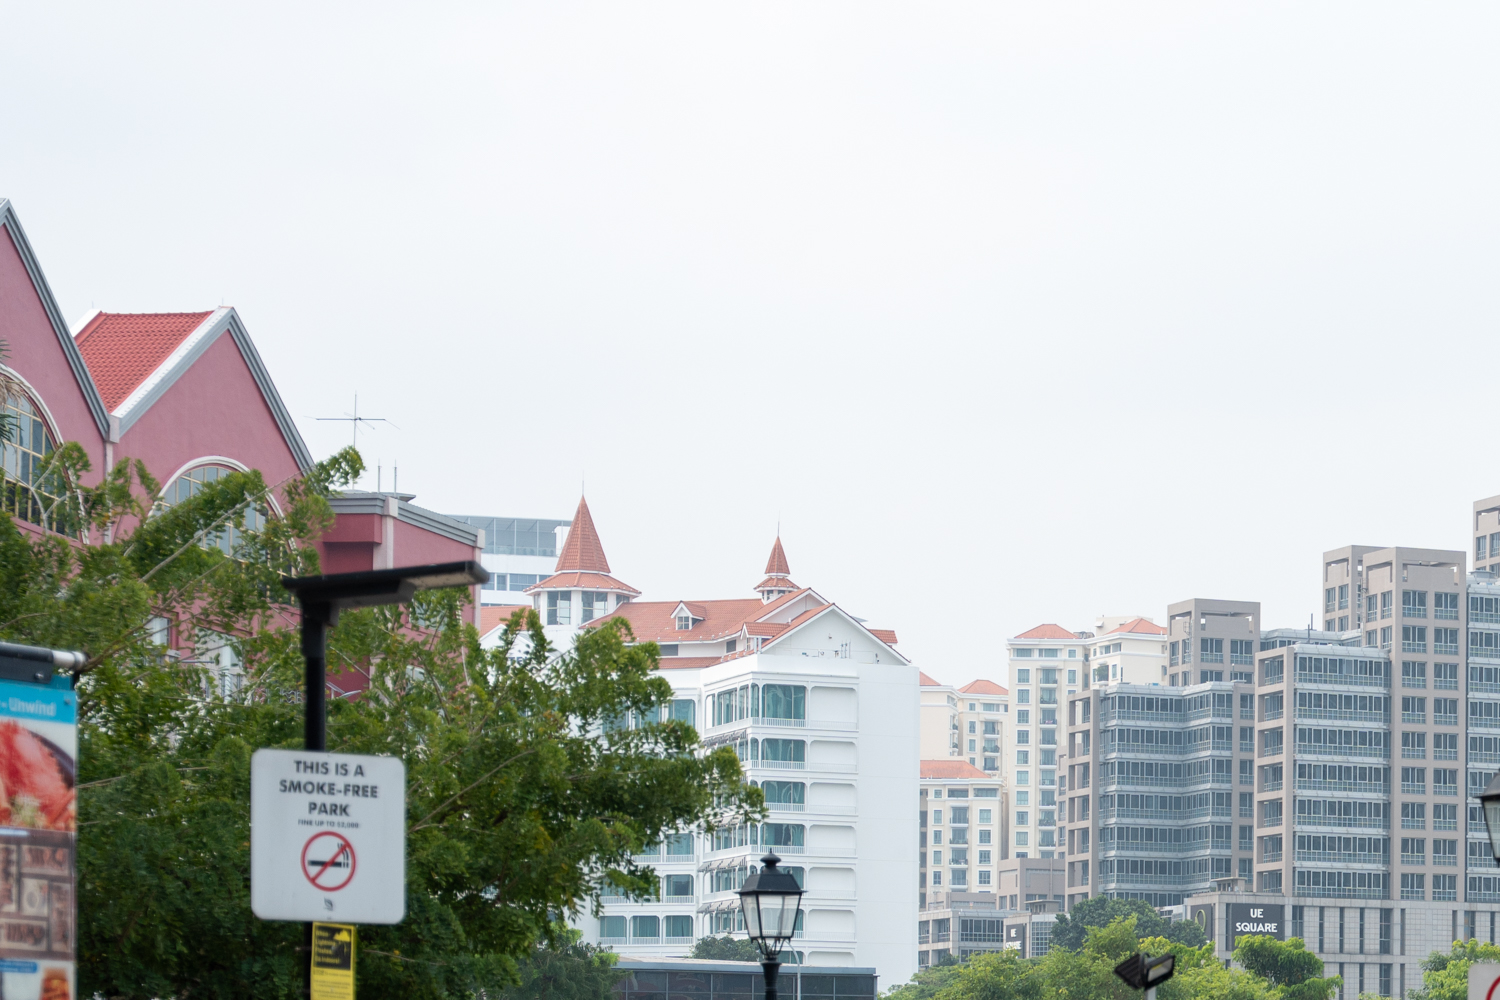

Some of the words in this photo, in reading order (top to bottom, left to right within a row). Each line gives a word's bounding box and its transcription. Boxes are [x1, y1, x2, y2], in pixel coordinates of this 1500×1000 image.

[294, 760, 329, 775] THIS
[335, 762, 348, 777] IS
[353, 764, 365, 777] A
[279, 779, 378, 799] SMOKE-FREE
[308, 801, 350, 817] PARK
[1250, 909, 1263, 918] UE
[1236, 923, 1277, 932] SQUARE
